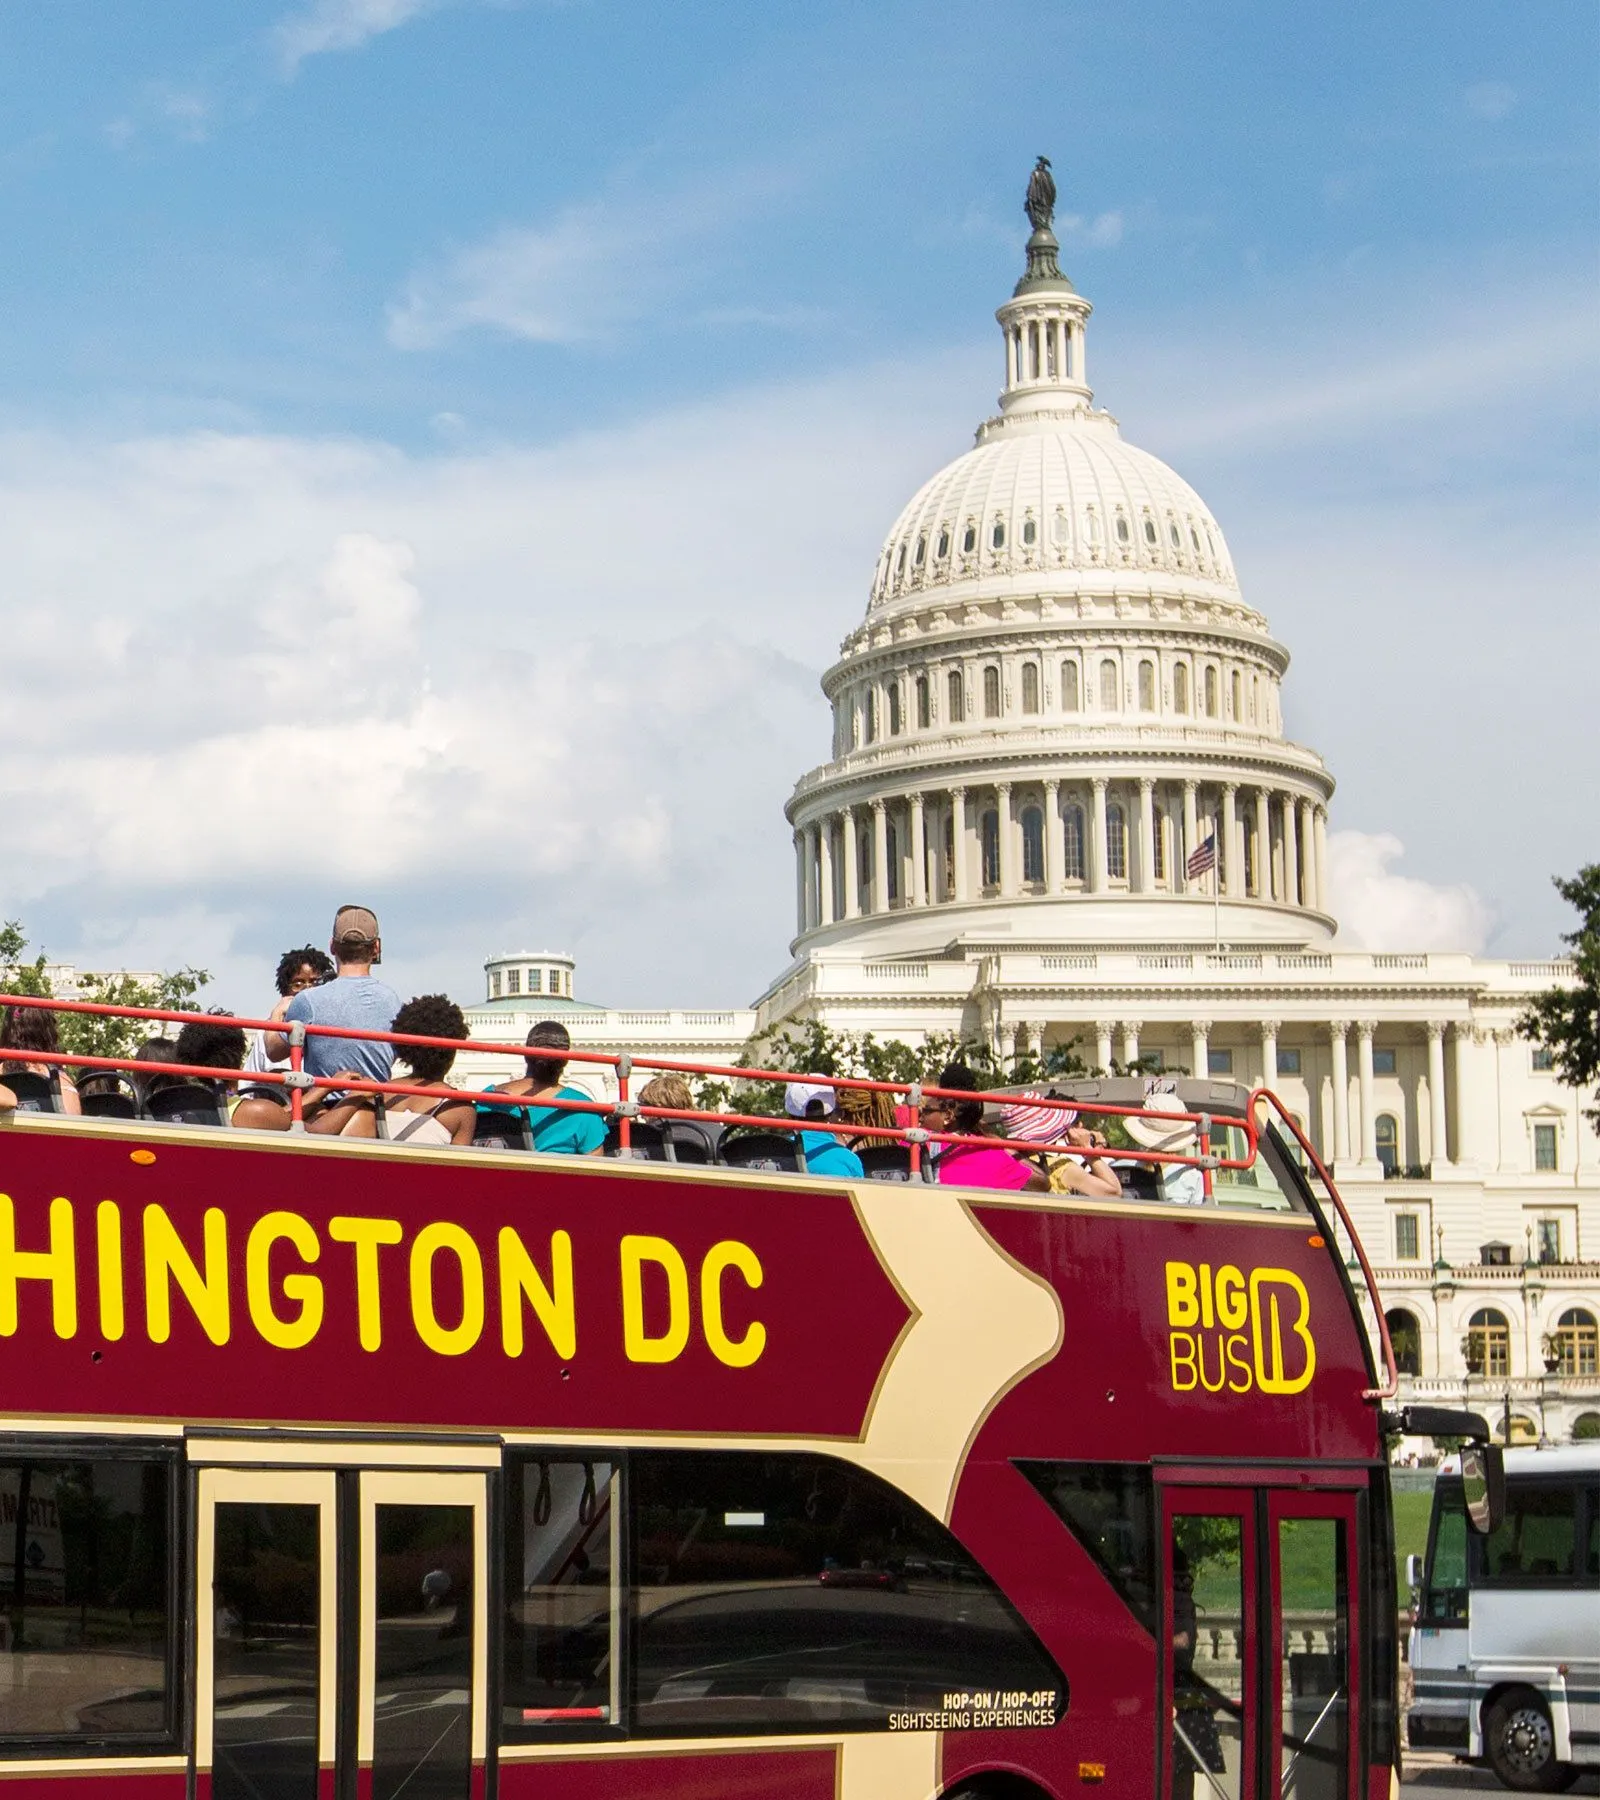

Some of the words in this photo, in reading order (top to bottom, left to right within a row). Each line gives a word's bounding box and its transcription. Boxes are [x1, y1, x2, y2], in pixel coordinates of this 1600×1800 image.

[620, 1235, 766, 1367] DC
[1165, 1262, 1248, 1330] BIG
[1170, 1331, 1253, 1393] BUS
[888, 1711, 970, 1730] SIGHTSEEING
[973, 1709, 1056, 1728] EXPERIENCES
[943, 1692, 992, 1710] HOP-ON
[1002, 1690, 1056, 1709] HOP-OFF
